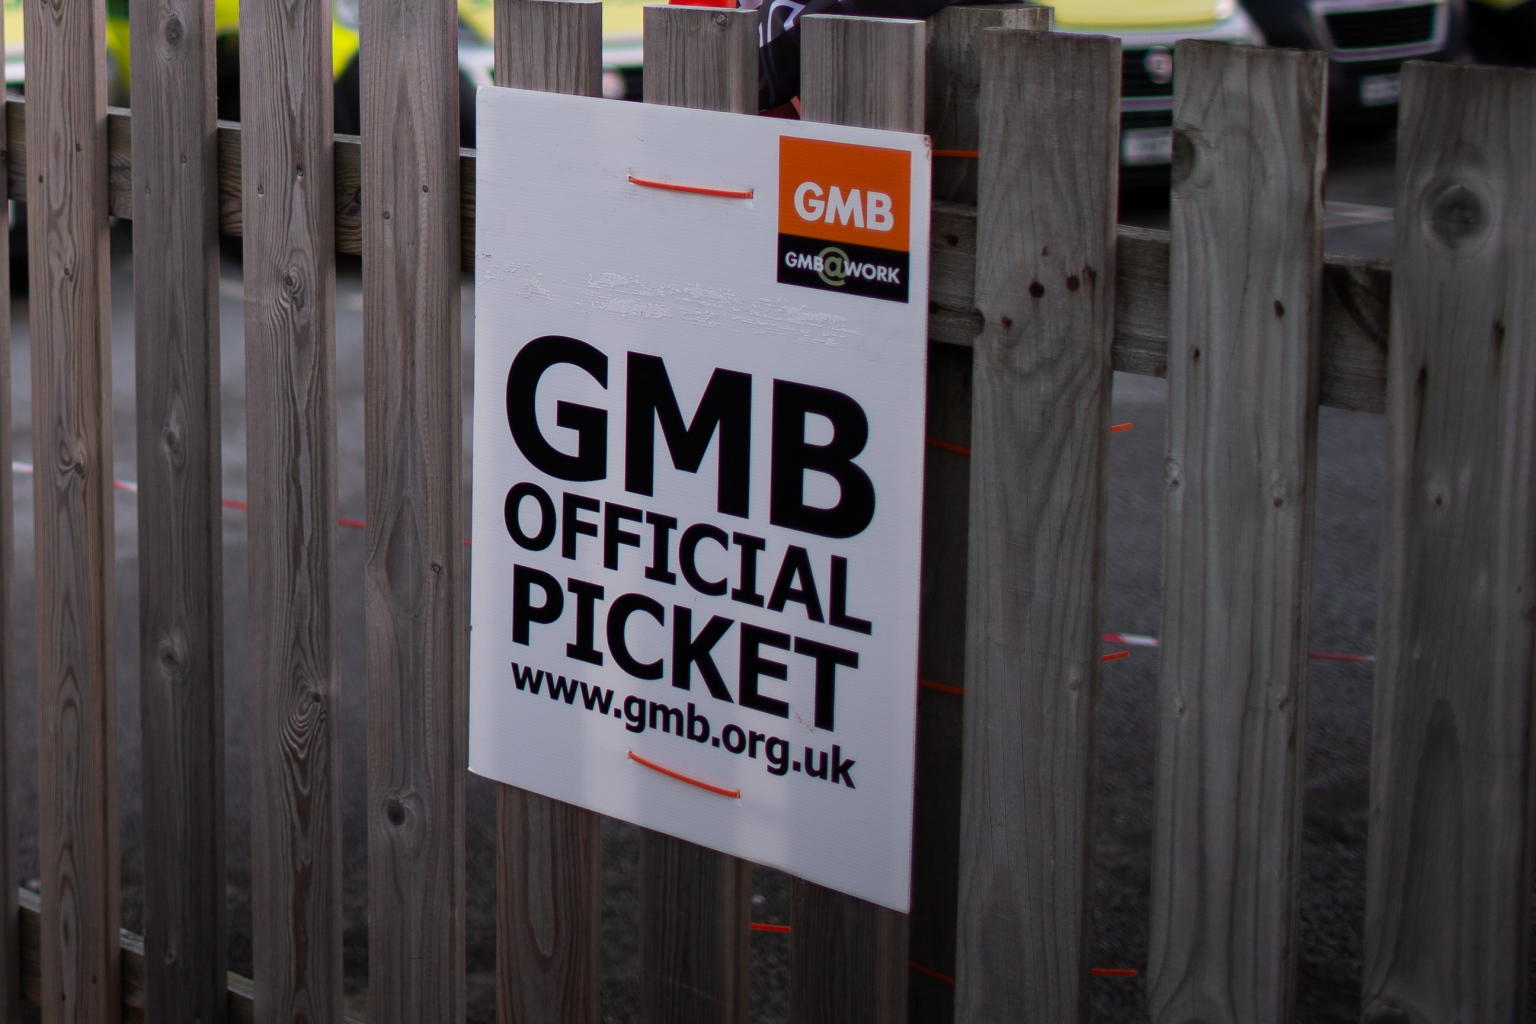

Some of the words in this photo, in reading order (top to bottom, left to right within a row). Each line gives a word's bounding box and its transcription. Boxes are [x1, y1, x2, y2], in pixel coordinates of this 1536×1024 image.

[785, 247, 900, 286] GMB@WORK
[794, 181, 894, 232] GMB
[506, 335, 875, 539] GMB
[504, 482, 872, 635] OFFICIAL
[512, 563, 858, 732] PICKET
[511, 662, 855, 789] www.gmb.org.uk
